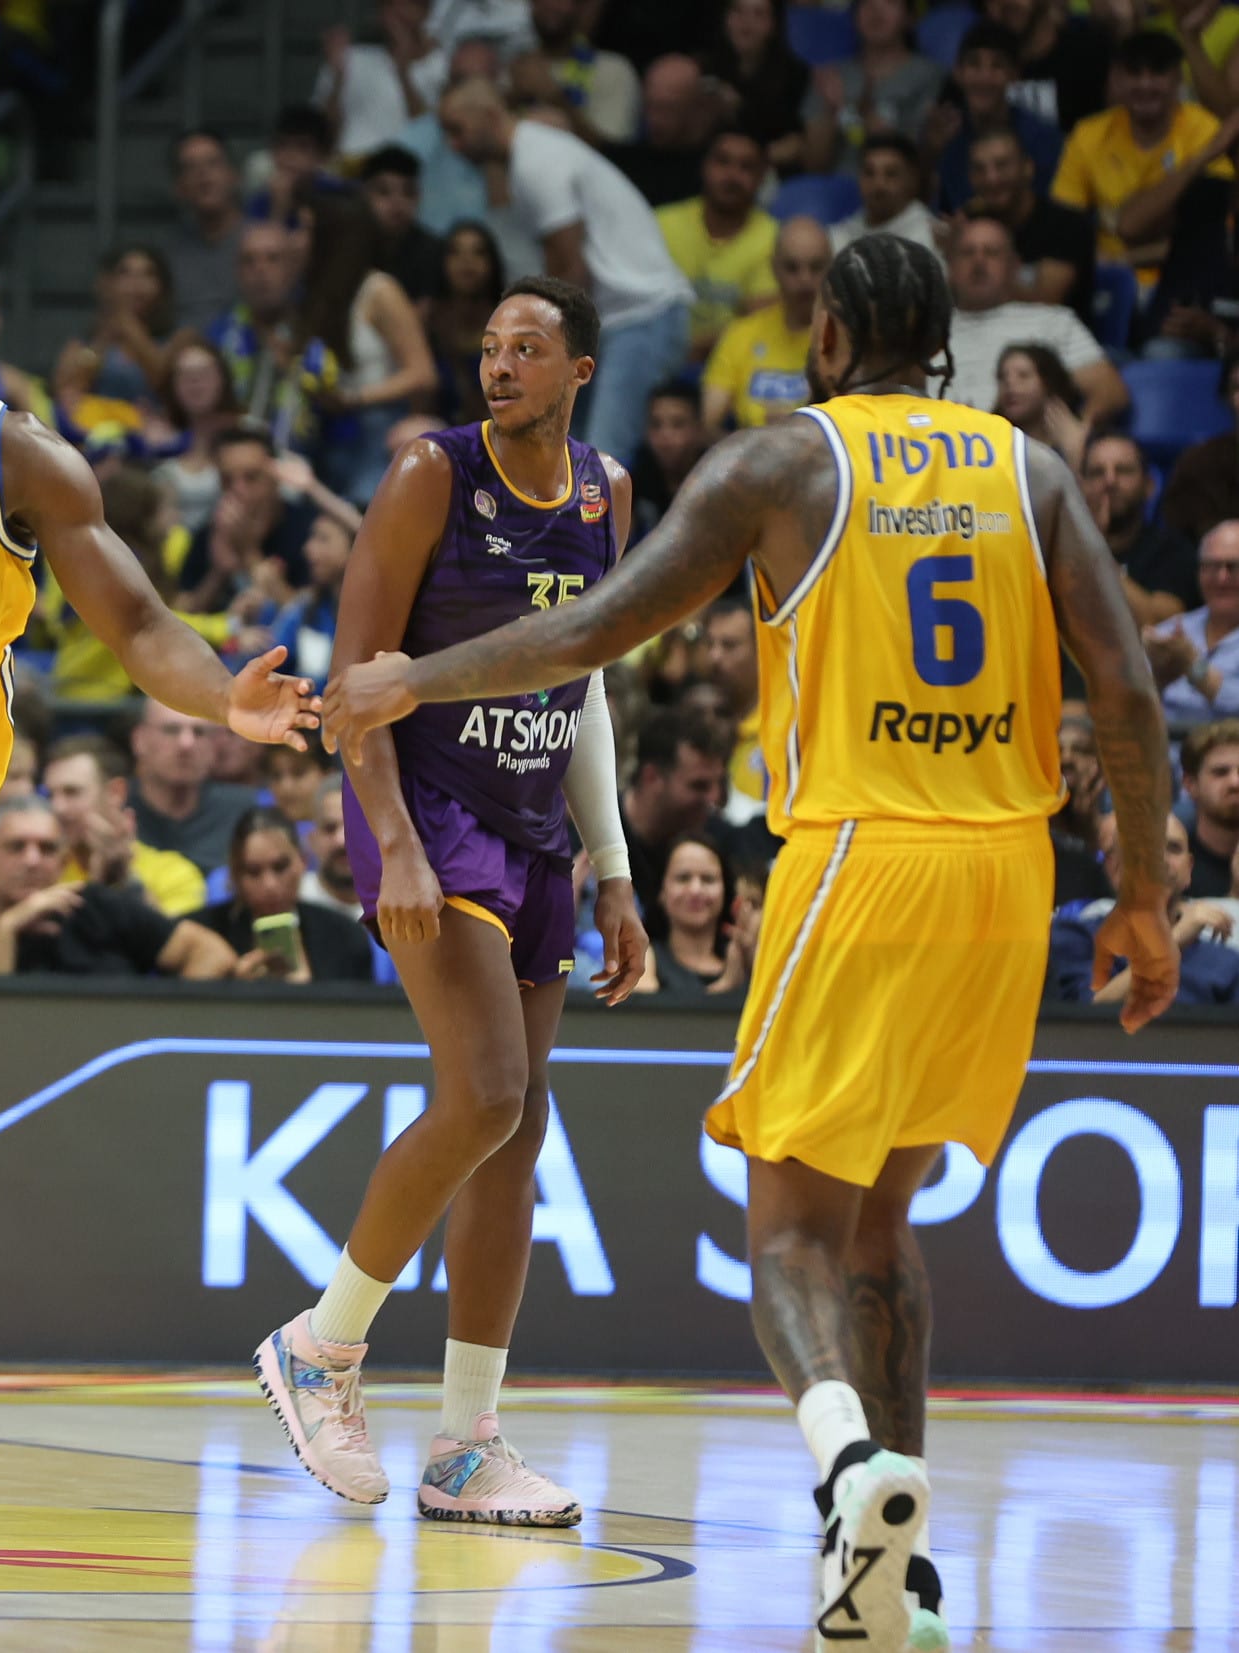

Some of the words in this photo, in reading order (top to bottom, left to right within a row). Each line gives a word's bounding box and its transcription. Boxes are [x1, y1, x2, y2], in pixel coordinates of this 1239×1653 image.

[867, 431, 996, 484] מרטין
[906, 554, 986, 687] 6
[458, 705, 582, 752] ATSMON
[868, 701, 1017, 755] Rapyd
[496, 752, 551, 775] Playgrounds
